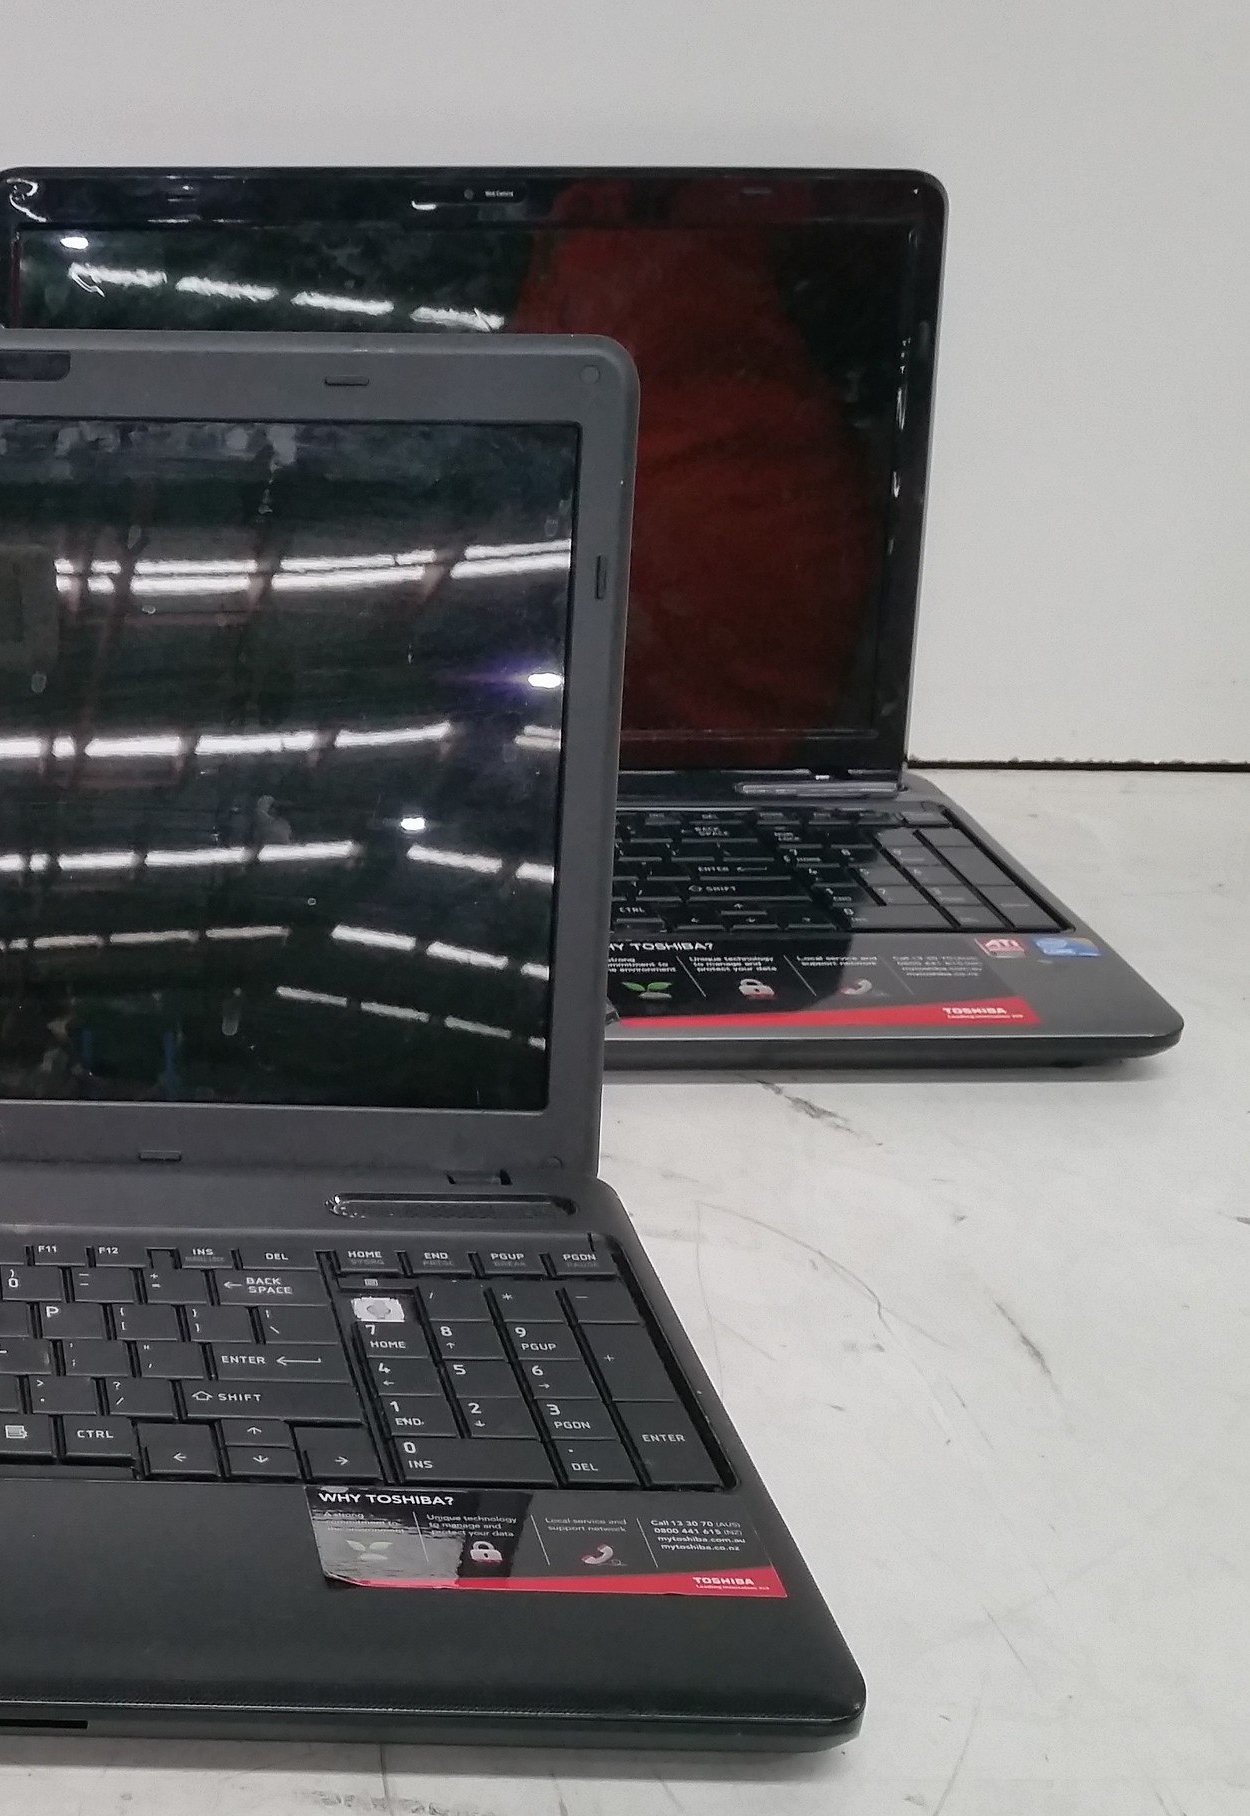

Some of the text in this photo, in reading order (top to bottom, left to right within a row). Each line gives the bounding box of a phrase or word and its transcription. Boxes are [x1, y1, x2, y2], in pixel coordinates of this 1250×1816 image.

[630, 942, 713, 951] TOSHIBA?
[9, 1278, 18, 1287] 0
[246, 1277, 281, 1285] BACK
[249, 1286, 292, 1294] SPACE
[46, 1306, 59, 1317] P
[365, 1325, 375, 1335] 7
[441, 1326, 452, 1336] 8
[515, 1327, 526, 1337] 9
[222, 1356, 265, 1364] ENTER
[379, 1363, 390, 1373] 4
[453, 1364, 466, 1375] 5
[532, 1365, 543, 1375] 6
[390, 1401, 399, 1412] 1
[468, 1403, 481, 1413] 2
[547, 1404, 560, 1415] 3
[77, 1430, 113, 1438] CTRL
[642, 1434, 685, 1442] ENTER
[404, 1442, 416, 1453] 0
[572, 1463, 598, 1471] DEL
[318, 1493, 454, 1505] WHY TOSHIBA?
[426, 1514, 517, 1524] Unique technology
[441, 1523, 481, 1531] manage
[693, 1577, 754, 1585] TOSHIBA
